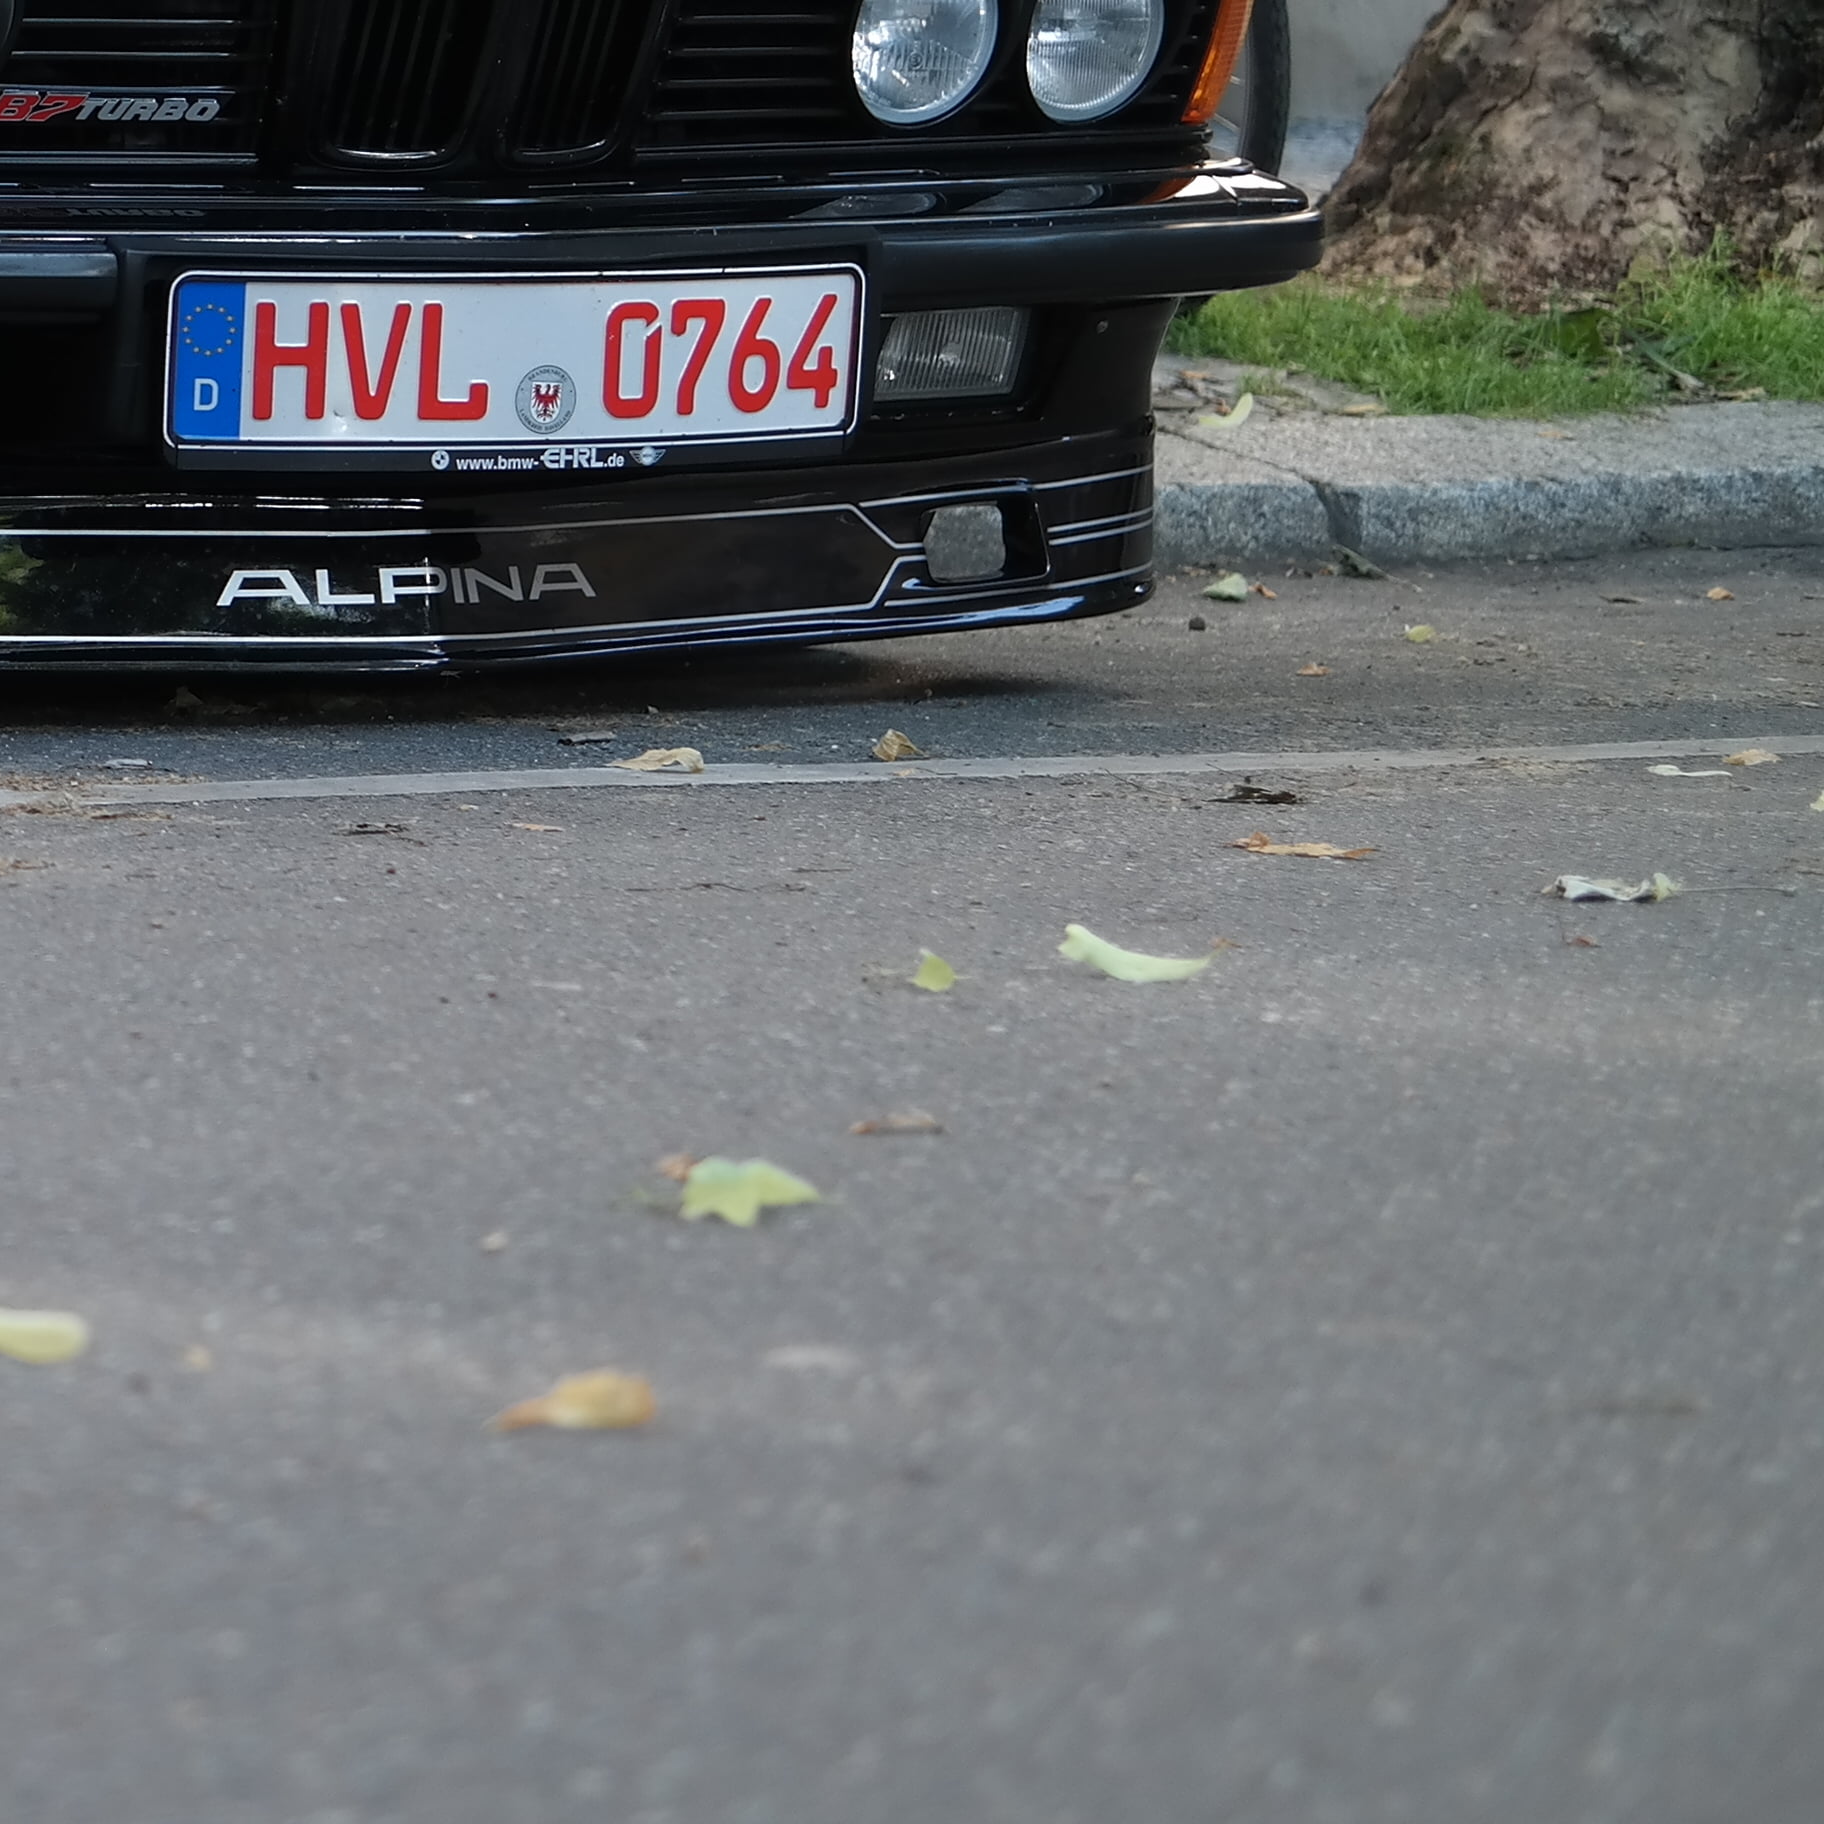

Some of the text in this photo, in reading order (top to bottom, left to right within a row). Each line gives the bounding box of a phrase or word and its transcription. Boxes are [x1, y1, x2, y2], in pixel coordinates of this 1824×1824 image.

[251, 293, 839, 422] HVL 0764
[193, 378, 219, 412] D
[216, 562, 598, 608] ALPINA
